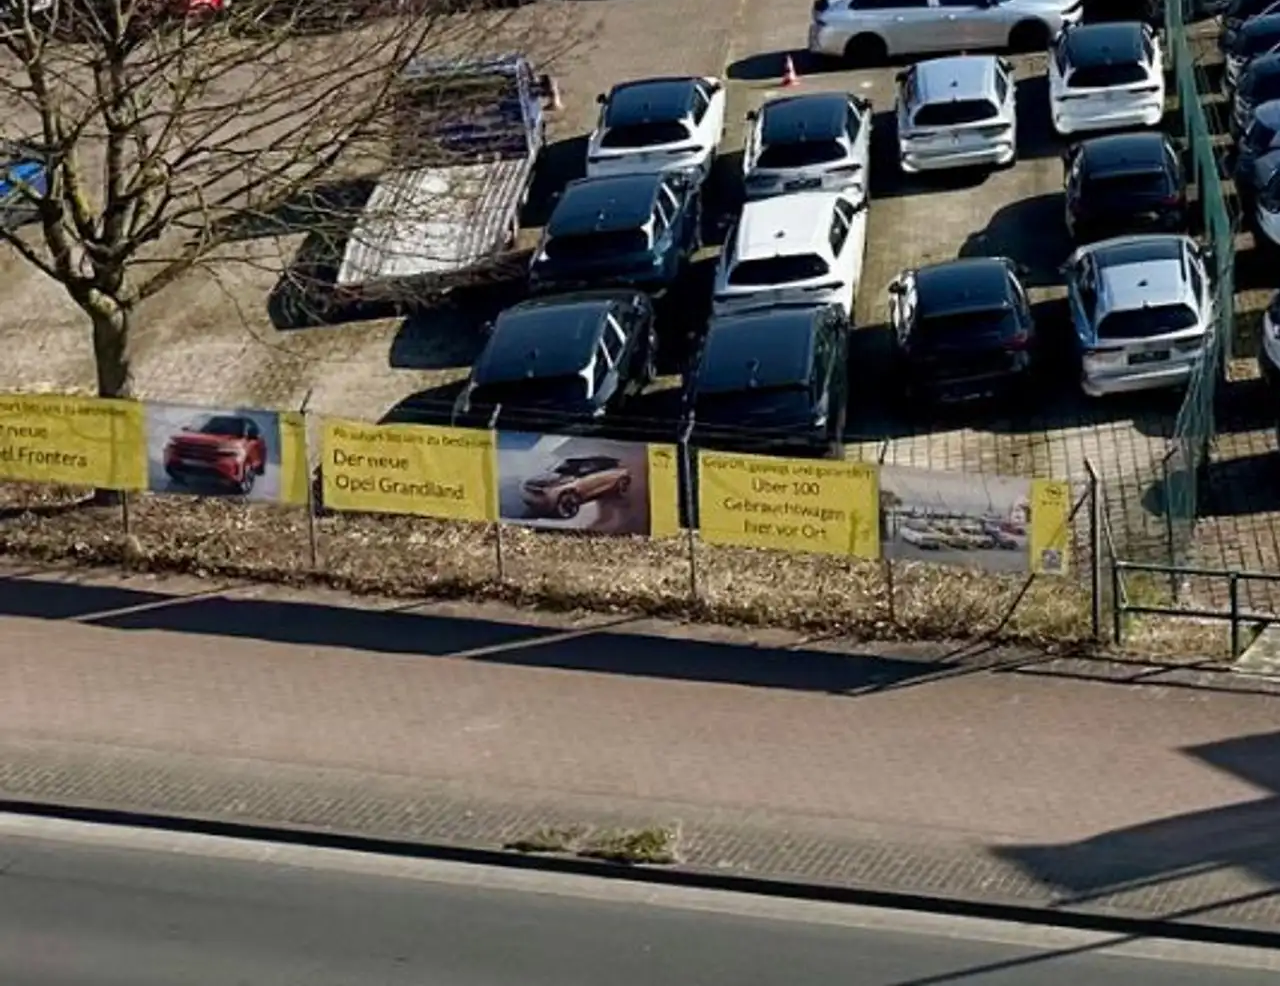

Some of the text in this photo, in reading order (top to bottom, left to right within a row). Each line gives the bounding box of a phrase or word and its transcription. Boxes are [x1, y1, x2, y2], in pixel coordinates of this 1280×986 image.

[18, 446, 88, 467] Frontera
[333, 448, 409, 469] Der neue
[335, 474, 464, 500] Opel Grandland
[752, 477, 820, 495] Über 100
[802, 525, 826, 539] Ort
